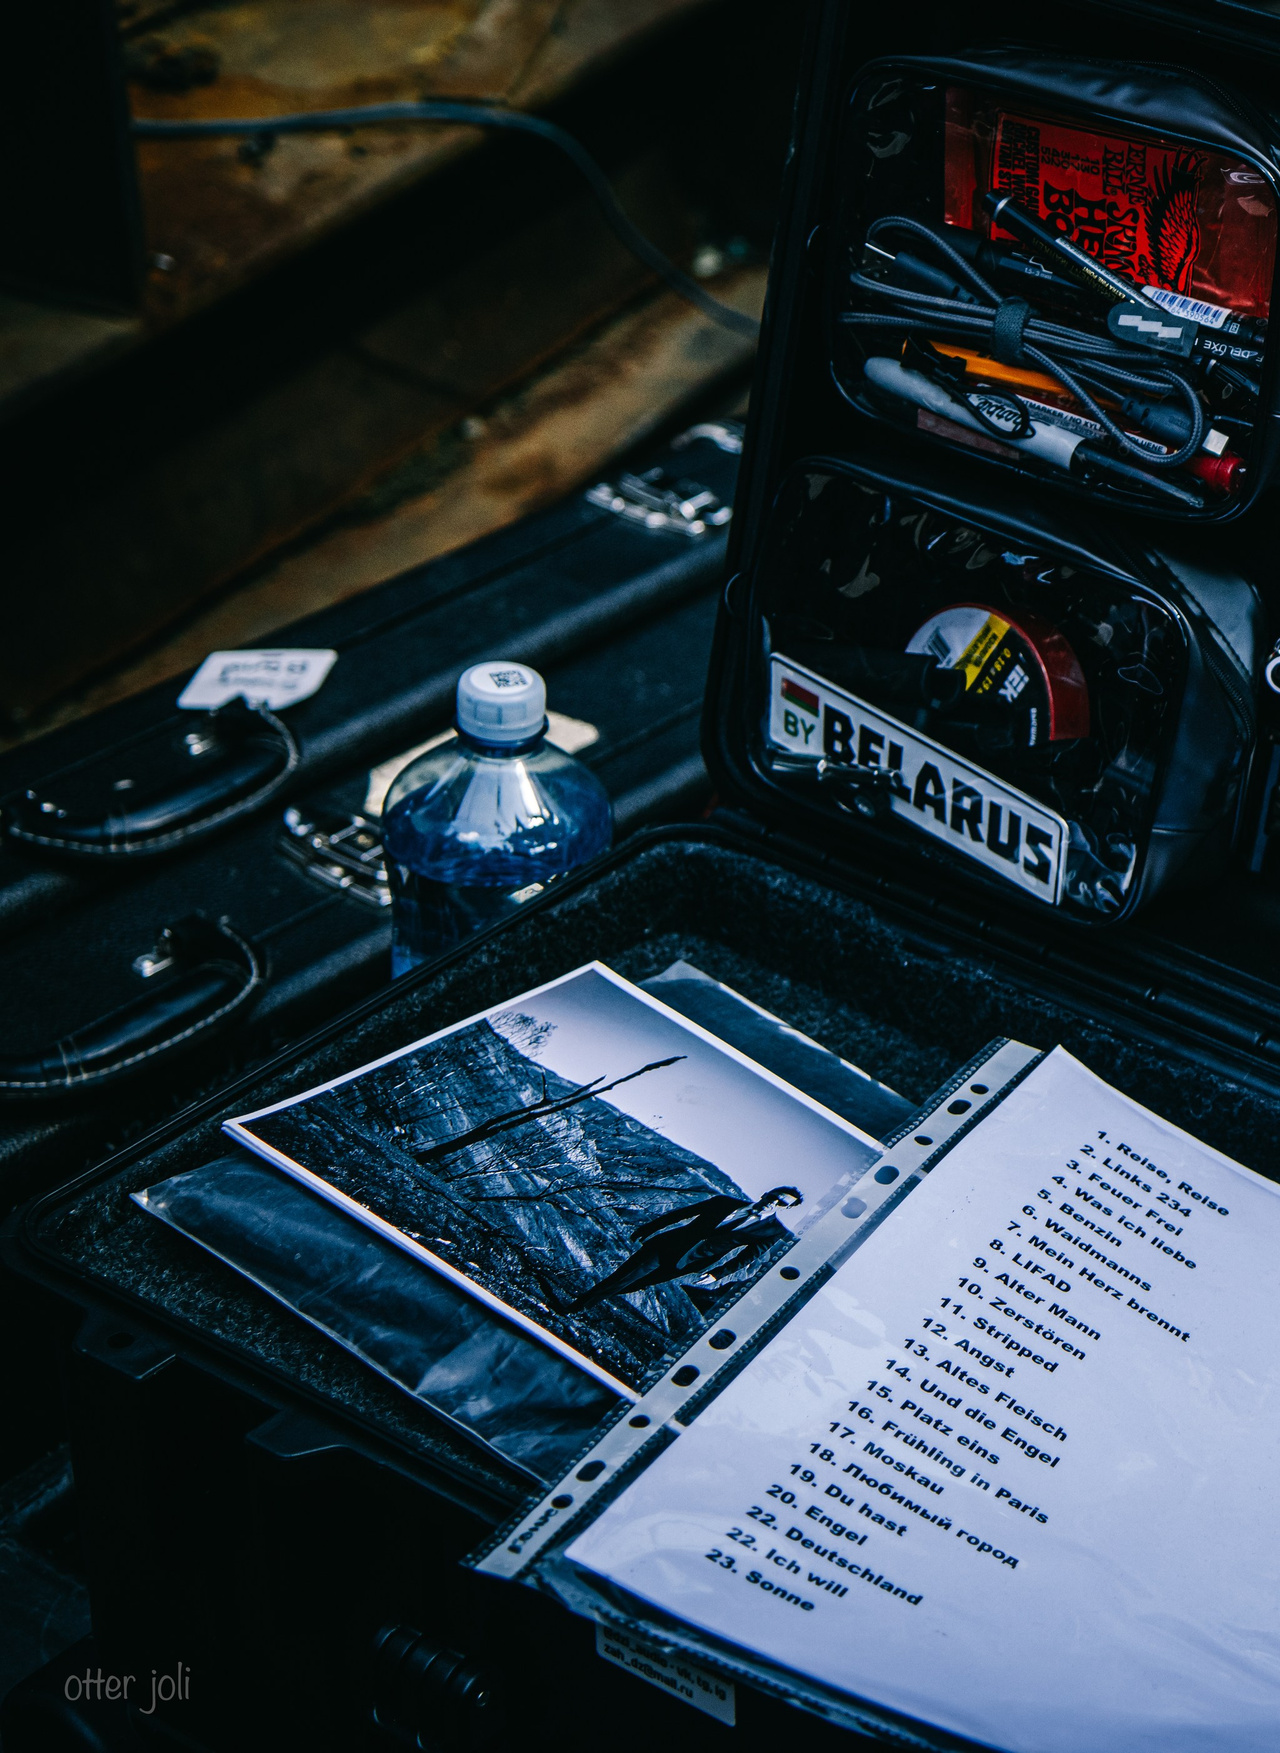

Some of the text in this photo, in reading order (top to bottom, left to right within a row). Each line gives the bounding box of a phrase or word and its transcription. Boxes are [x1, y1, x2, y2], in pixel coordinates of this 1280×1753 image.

[1013, 123, 1027, 173] NICKEL
[1027, 126, 1040, 217] CUSTOM GAU
[1041, 147, 1050, 166] 52
[1051, 150, 1061, 168] 42
[1071, 156, 1081, 172] 17
[1081, 158, 1090, 174] 13
[1090, 160, 1100, 175] 10
[1103, 144, 1124, 195] BALL
[1128, 143, 1147, 205] ERNIE
[1105, 200, 1141, 276] SKINN
[1081, 265, 1126, 300] EXTRA FINE POINT
[1202, 339, 1258, 360] DELUXE
[1068, 415, 1083, 425] NO
[784, 710, 814, 744] BY
[823, 703, 1052, 884] BELARUS
[1066, 1159, 1184, 1236] 3. Feuer Frei
[1079, 1145, 1192, 1217] 2. Links 234
[1097, 1131, 1230, 1216] 1. Reise, Reise
[1022, 1205, 1152, 1292] 6. Waidmanns
[1037, 1189, 1123, 1247] 5. Benzin
[1051, 1175, 1197, 1269] 4. Was ich liebe
[972, 1257, 1101, 1341] 9. Alter Mann
[989, 1239, 1071, 1293] 8. LIFAD
[1006, 1221, 1191, 1342] 7. Mein Herz brennt
[923, 1318, 1016, 1378] 12. Angst
[941, 1298, 1059, 1373] 11. Stripped
[957, 1277, 1086, 1360] 10. Zerstören
[866, 1380, 1000, 1465] 15. Platz eins
[885, 1359, 1060, 1469] 14. Und die Engel
[903, 1338, 1068, 1441] 13. Altes Fleisch
[828, 1421, 945, 1495] 17. Moskau
[847, 1400, 1049, 1524] 16. Frühling in Paris
[766, 1484, 869, 1546] 20. Engel
[789, 1463, 908, 1537] 19. Du hast
[809, 1442, 1019, 1569] 18. Любимый город
[705, 1548, 815, 1611] 23. Sonne
[726, 1527, 849, 1598] 22. Ich will
[746, 1506, 923, 1606] 22. Deutschland
